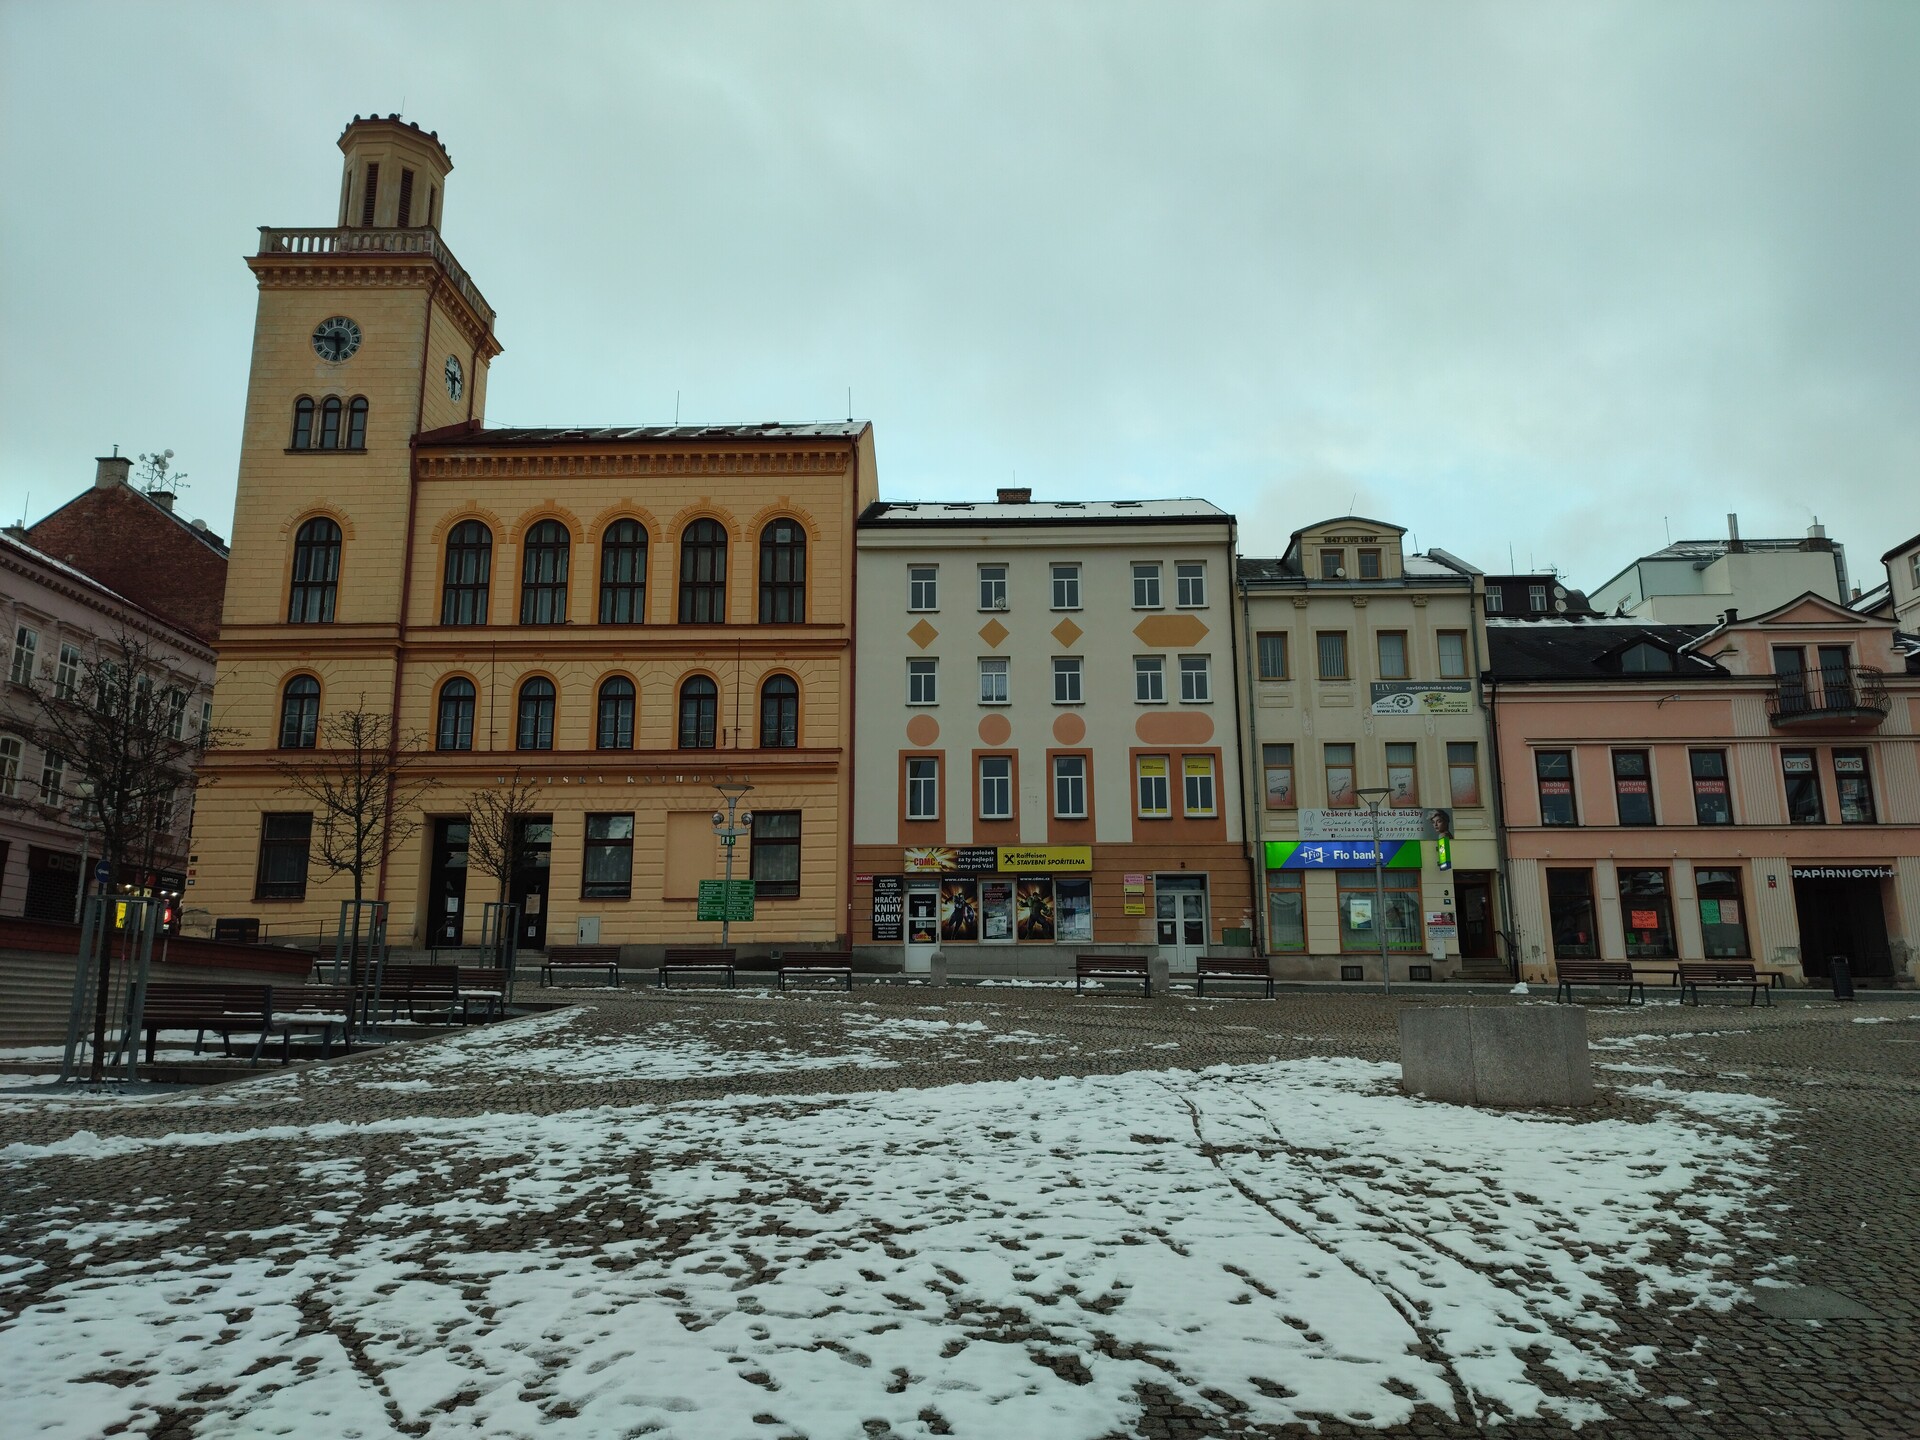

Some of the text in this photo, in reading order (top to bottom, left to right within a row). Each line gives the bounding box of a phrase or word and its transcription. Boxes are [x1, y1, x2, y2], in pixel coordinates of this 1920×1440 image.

[1398, 810, 1423, 818] služby
[1333, 850, 1350, 860] Fio
[875, 895, 901, 903] HRAČKY
[875, 904, 901, 912] KNIHY
[875, 913, 901, 922] DÁRKY
